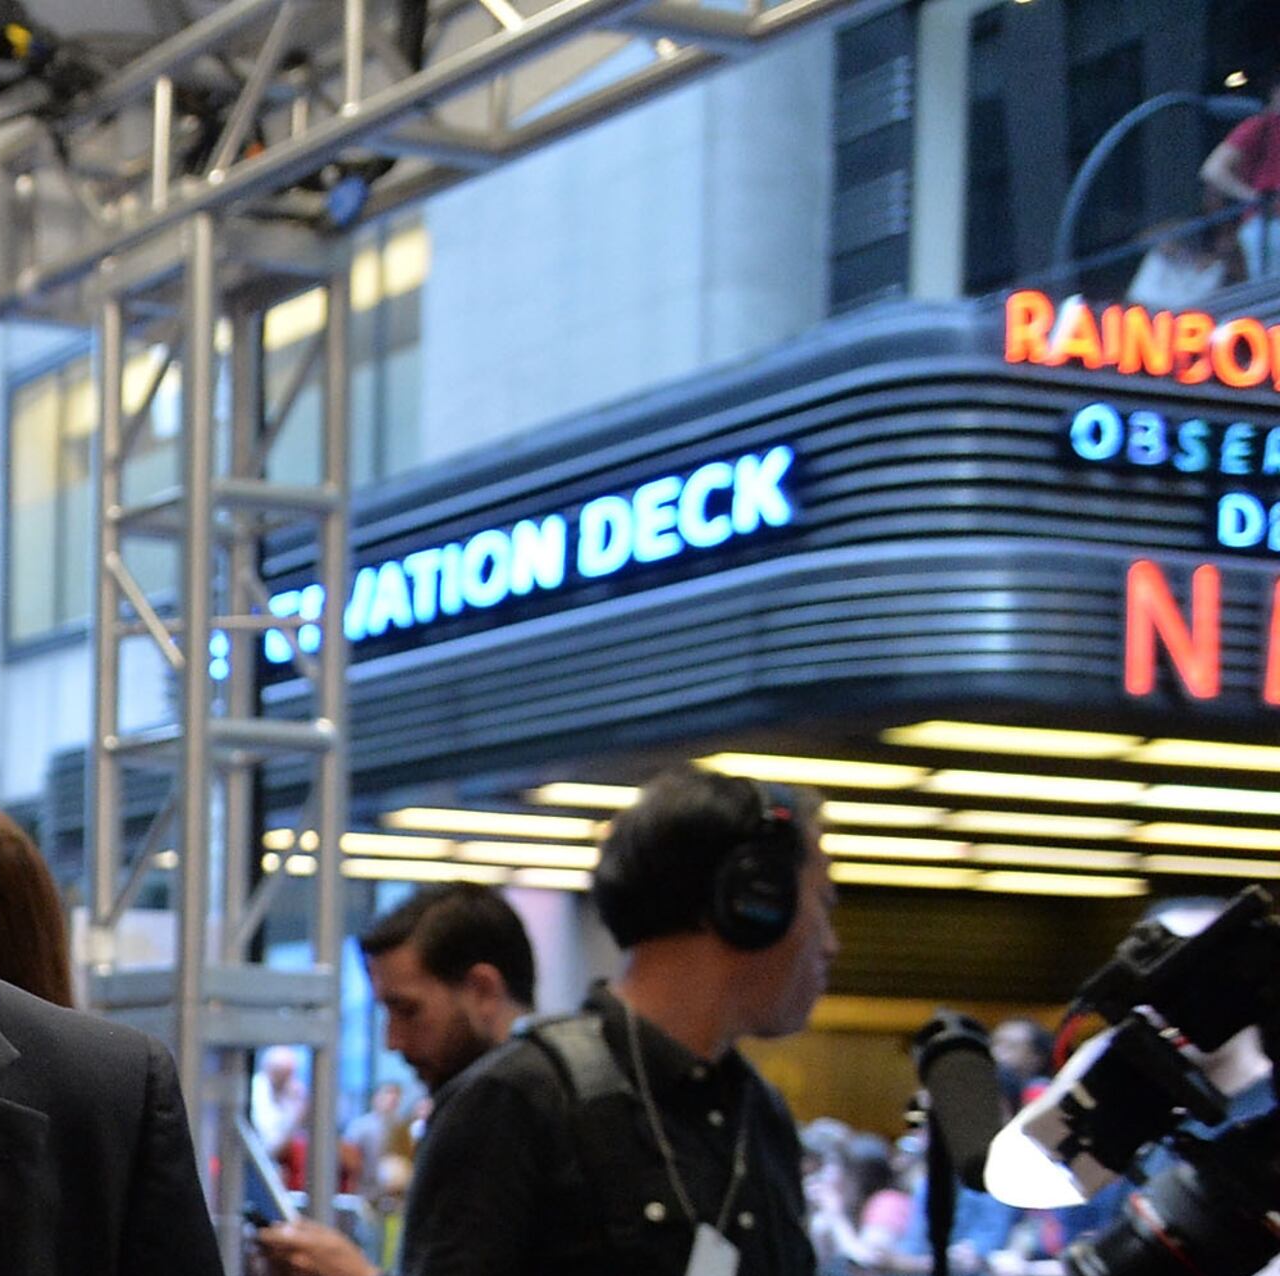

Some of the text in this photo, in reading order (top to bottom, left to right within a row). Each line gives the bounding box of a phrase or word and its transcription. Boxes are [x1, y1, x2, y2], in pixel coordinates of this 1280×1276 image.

[1004, 288, 1280, 393] RAINBO
[576, 445, 795, 578] DECK
[1124, 558, 1280, 707] N
